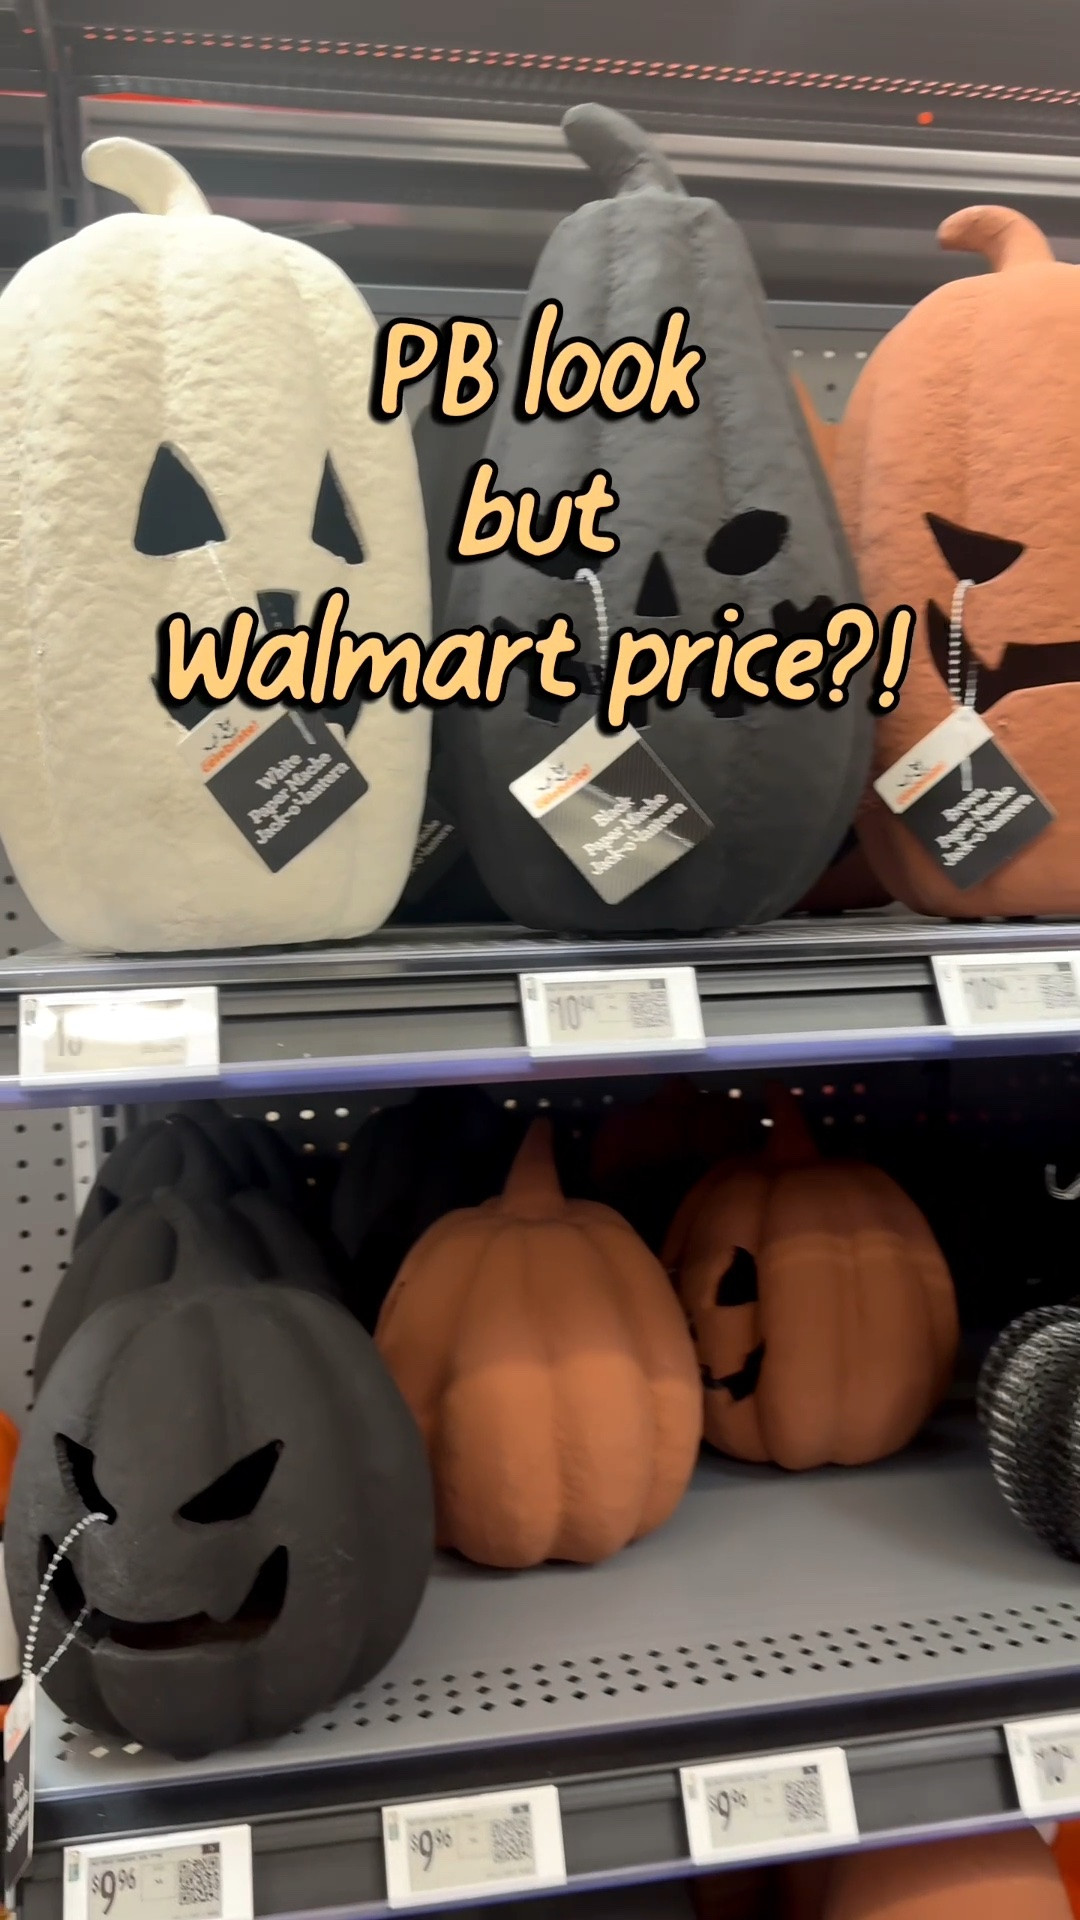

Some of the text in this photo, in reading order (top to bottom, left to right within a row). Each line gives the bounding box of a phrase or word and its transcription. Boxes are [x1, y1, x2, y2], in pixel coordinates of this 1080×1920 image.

[247, 753, 332, 825] Paper Mache
[255, 754, 302, 790] White
